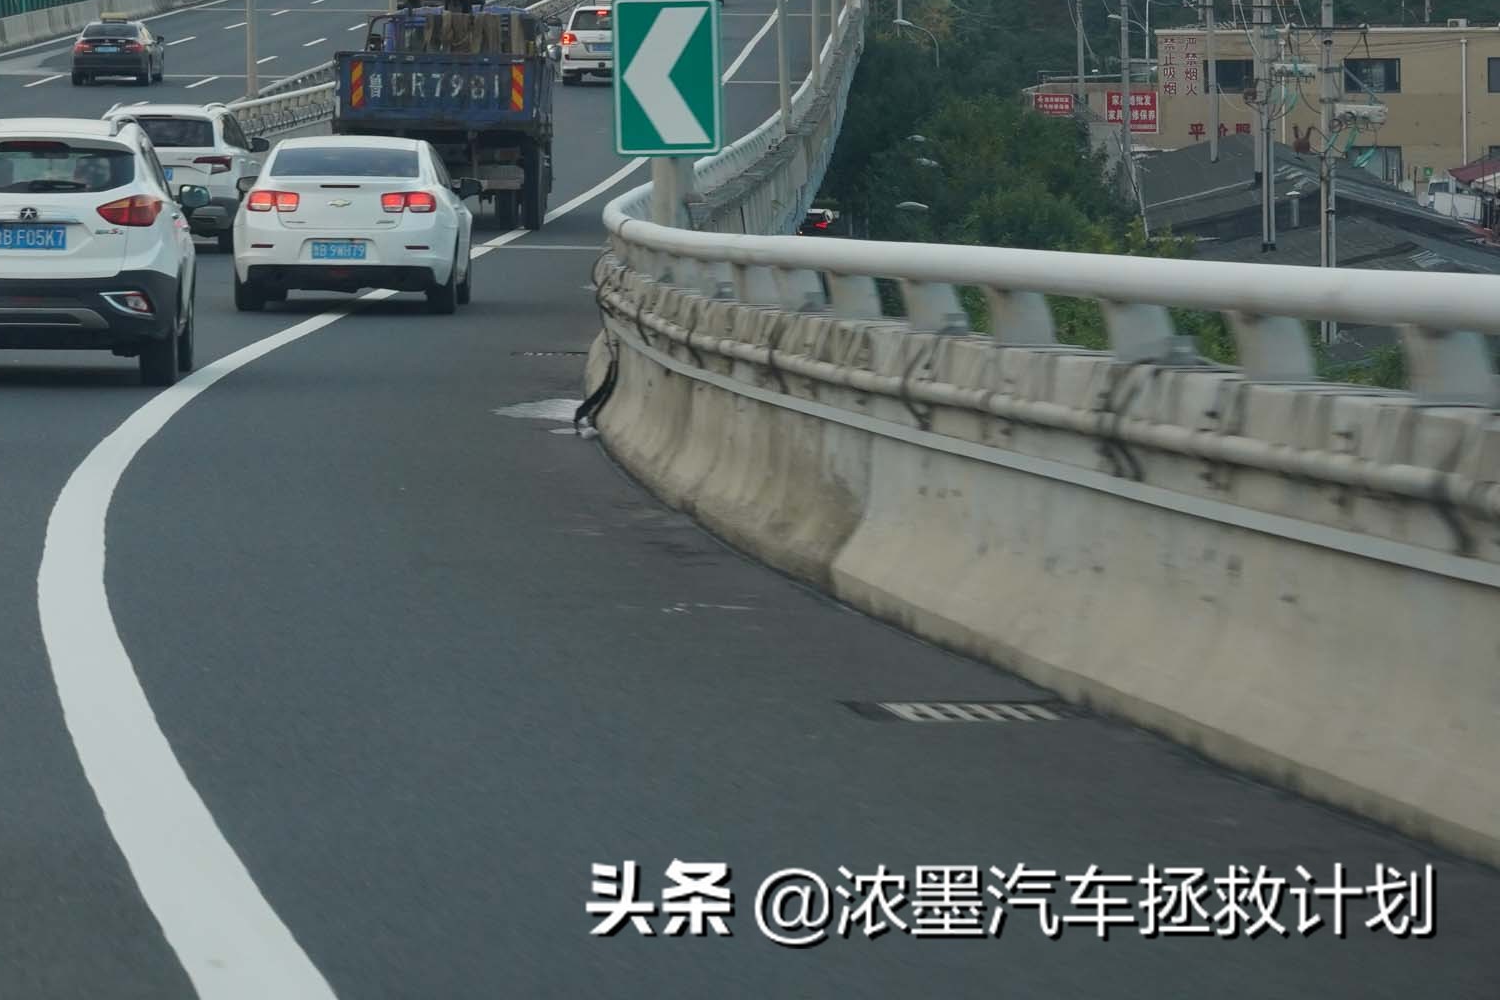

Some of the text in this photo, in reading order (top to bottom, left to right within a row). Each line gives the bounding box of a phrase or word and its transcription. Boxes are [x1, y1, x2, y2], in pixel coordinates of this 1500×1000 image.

[1163, 38, 1177, 96] 禁止吸烟
[1184, 37, 1198, 96] 严禁烟火
[1107, 109, 1156, 121] 家具修保养
